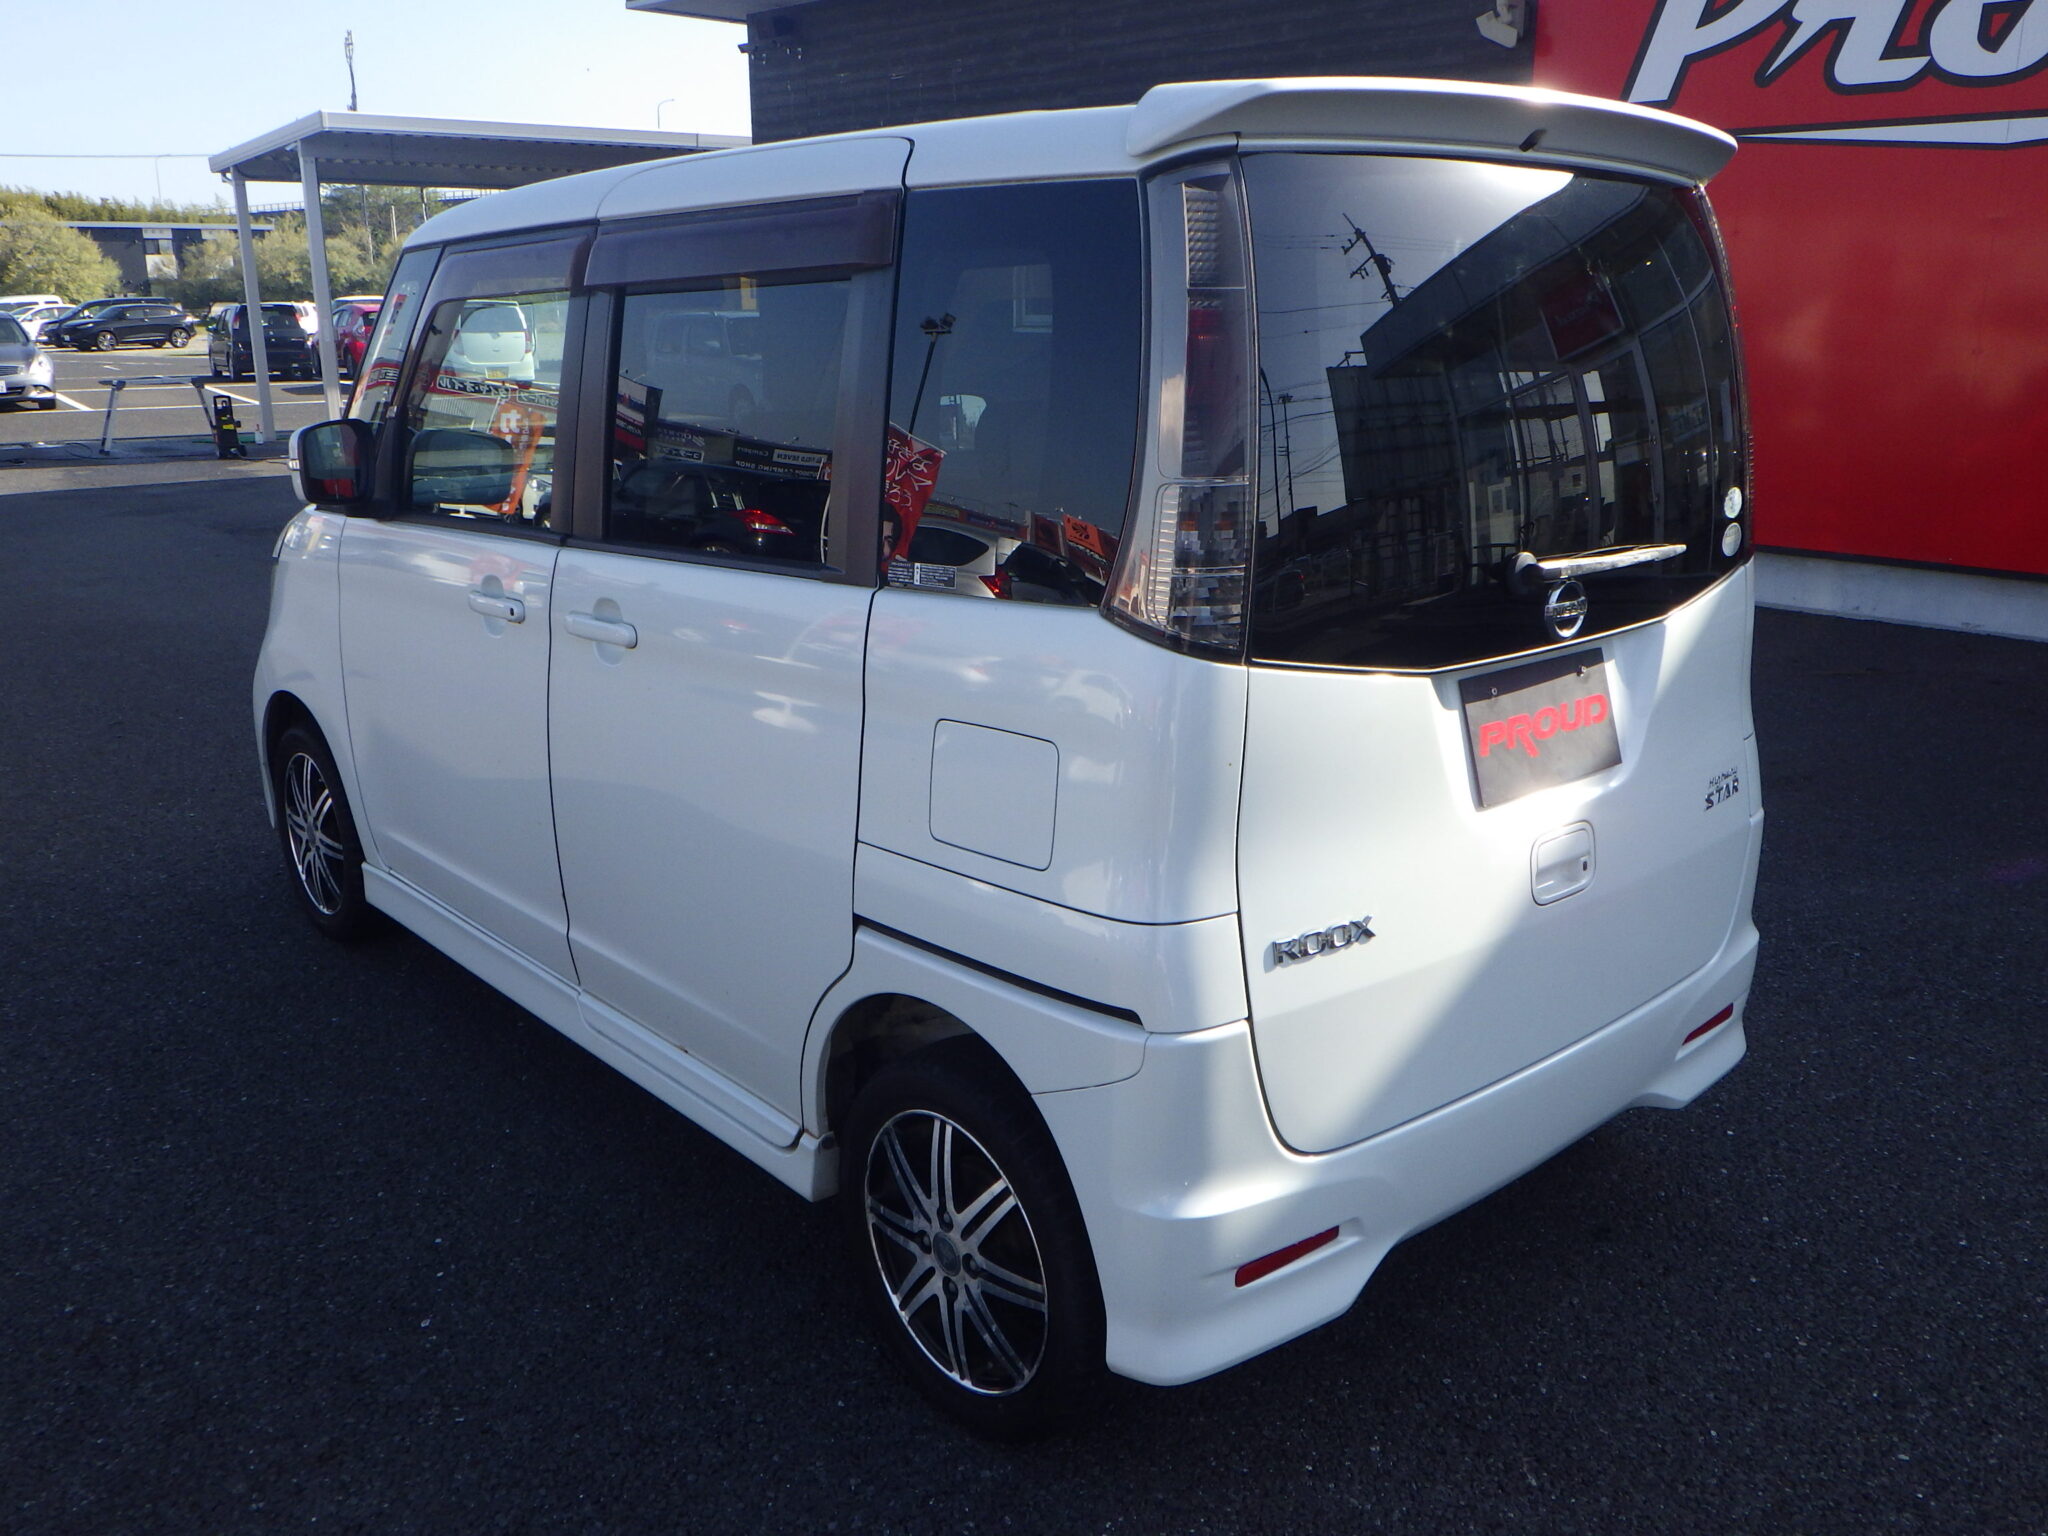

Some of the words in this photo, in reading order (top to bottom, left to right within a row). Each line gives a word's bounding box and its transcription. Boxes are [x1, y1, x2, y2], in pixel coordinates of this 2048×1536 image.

[1478, 693, 1609, 757] PROUD
[1704, 777, 1739, 811] STAR
[1272, 915, 1377, 965] ROOX
